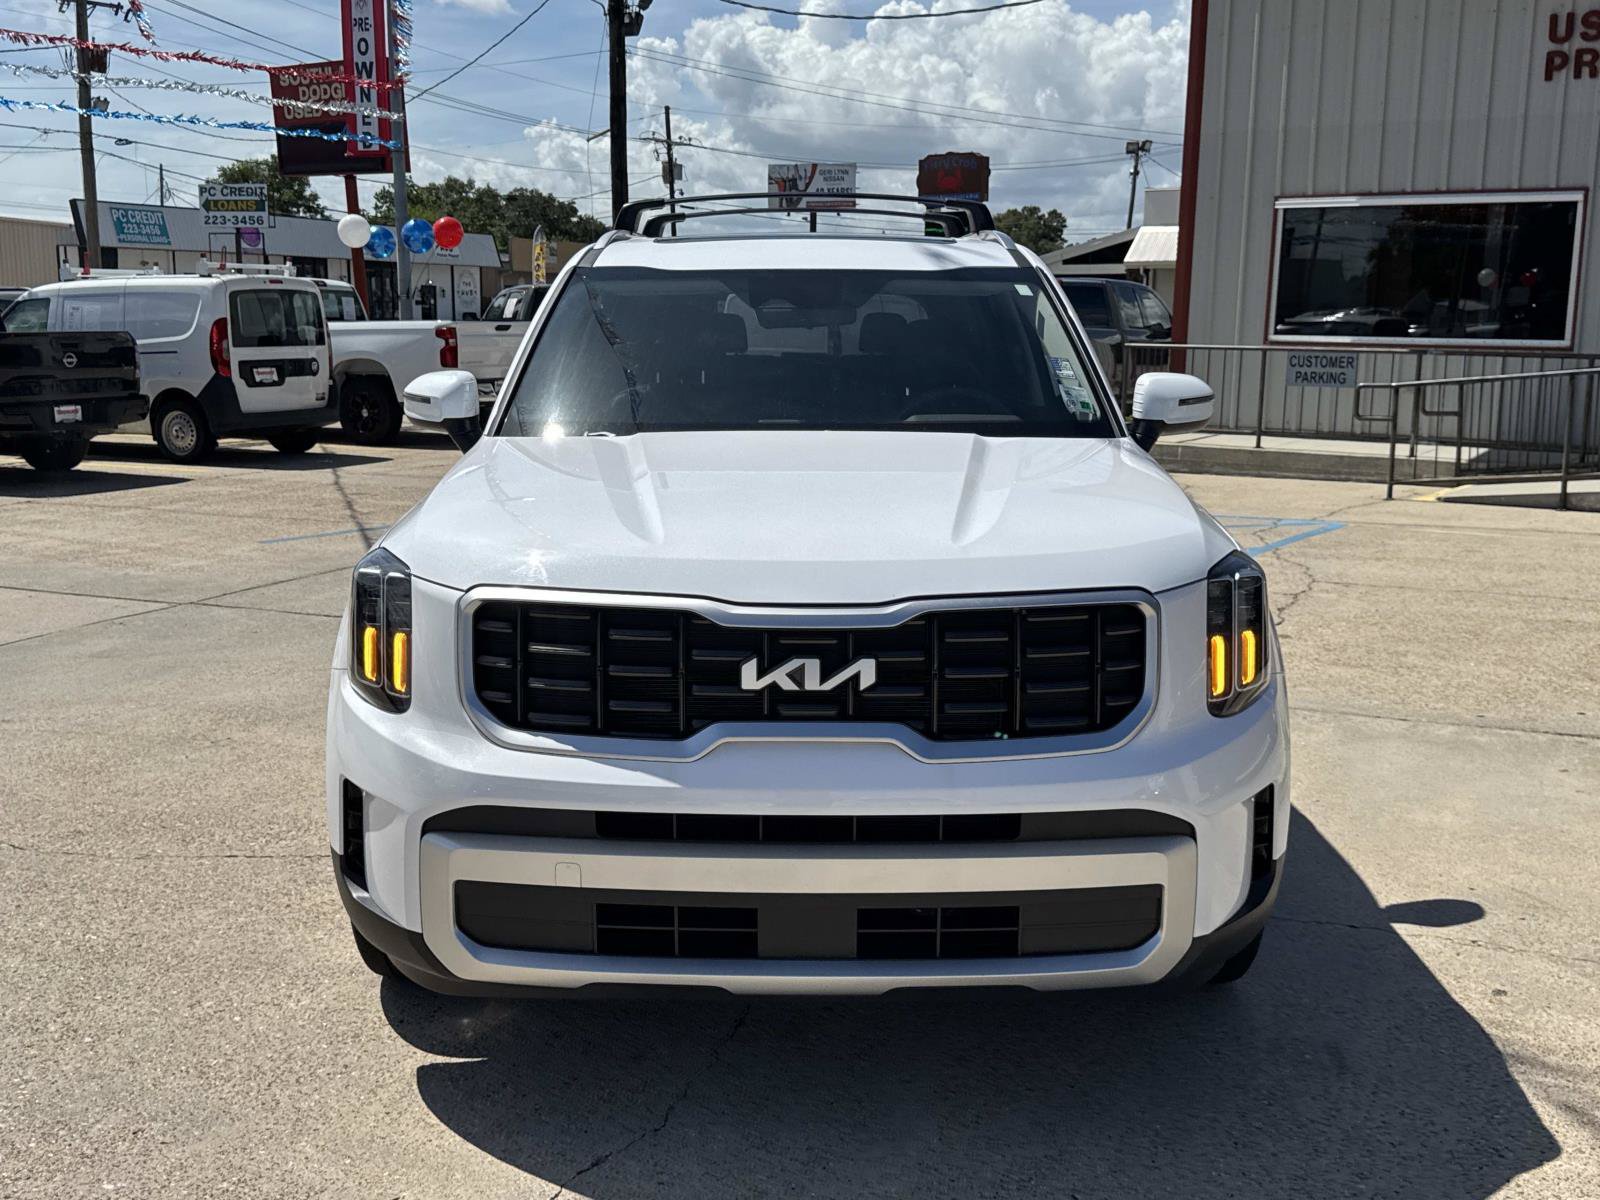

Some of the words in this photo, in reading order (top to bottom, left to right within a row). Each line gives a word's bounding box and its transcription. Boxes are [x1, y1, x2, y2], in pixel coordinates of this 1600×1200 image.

[834, 167, 849, 175] LYNN
[201, 187, 216, 197] PC
[221, 186, 265, 198] CREDIT
[209, 201, 257, 212] LOANS
[112, 209, 126, 222] PC
[128, 211, 163, 225] CREDIT
[204, 216, 265, 226] 223-3456
[123, 224, 161, 236] 223-3456
[1289, 355, 1354, 369] CUSTOMER
[1294, 371, 1346, 385] PARKING
